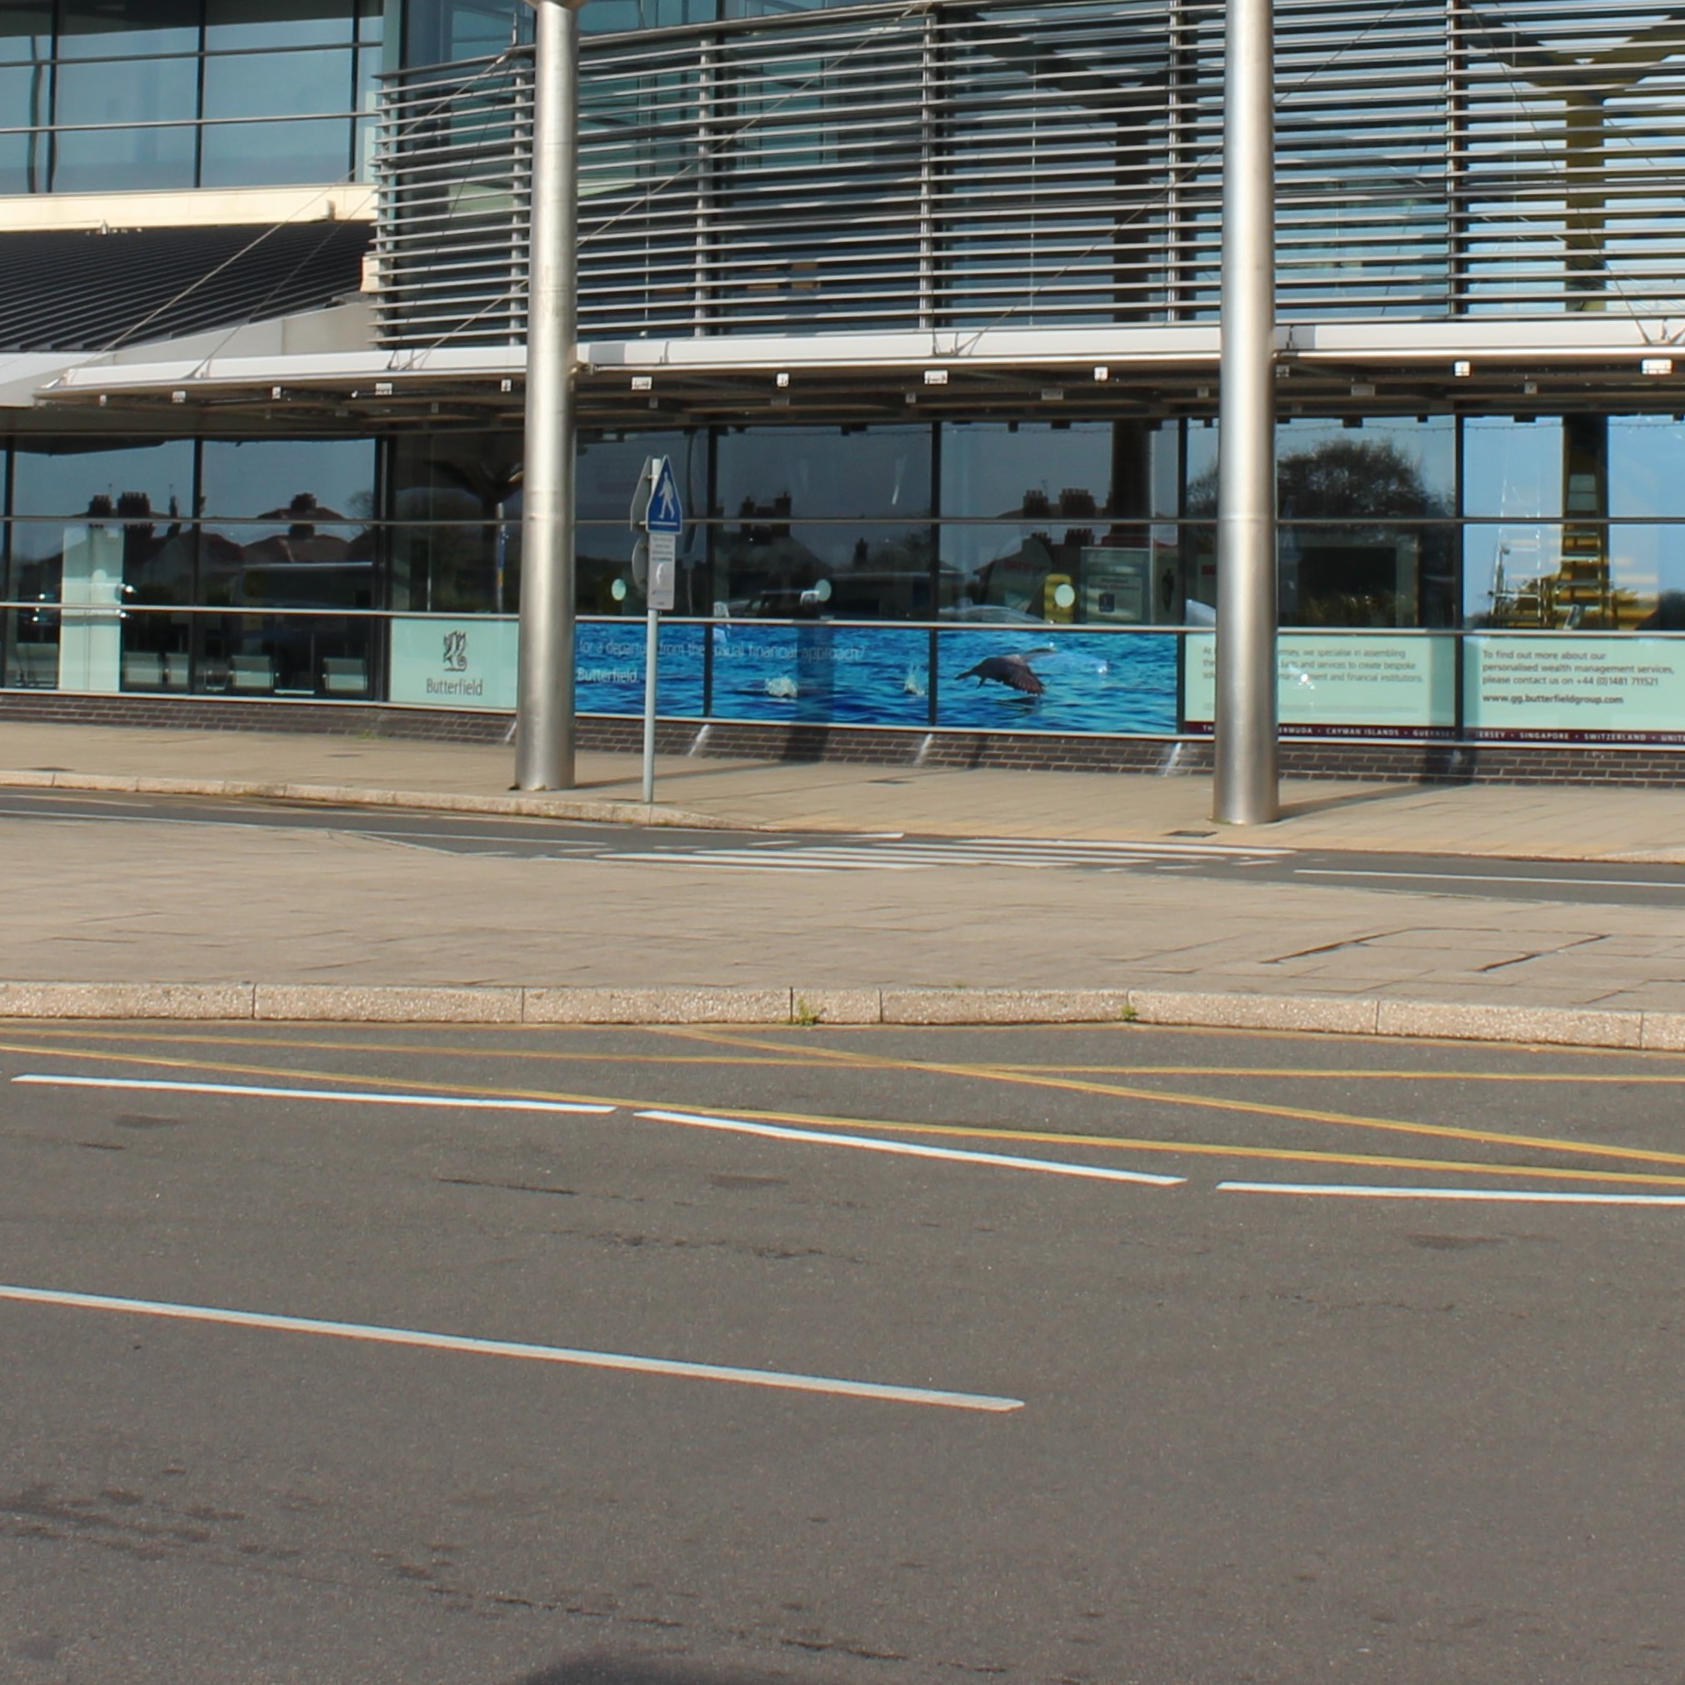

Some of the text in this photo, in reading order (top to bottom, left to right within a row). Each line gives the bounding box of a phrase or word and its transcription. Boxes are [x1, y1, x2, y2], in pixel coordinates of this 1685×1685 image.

[1482, 650, 1493, 659] To
[1495, 650, 1514, 659] find
[1516, 652, 1532, 660] out
[1561, 651, 1588, 661] about
[1590, 653, 1606, 661] our
[1482, 663, 1539, 674] personalised
[1541, 664, 1572, 673] wealth
[1574, 666, 1635, 675] management
[426, 677, 483, 696] Butterfield
[1482, 675, 1511, 686] please
[1513, 676, 1547, 685] contact
[1576, 677, 1594, 686] +44
[1482, 694, 1624, 706] www.gg.butterfieldgroup.com
[1325, 727, 1361, 736] CAYMAN
[1364, 728, 1399, 737] ISLANDS
[1519, 731, 1569, 740] SINGAPORE
[1583, 732, 1647, 741] SWITZERLAND
